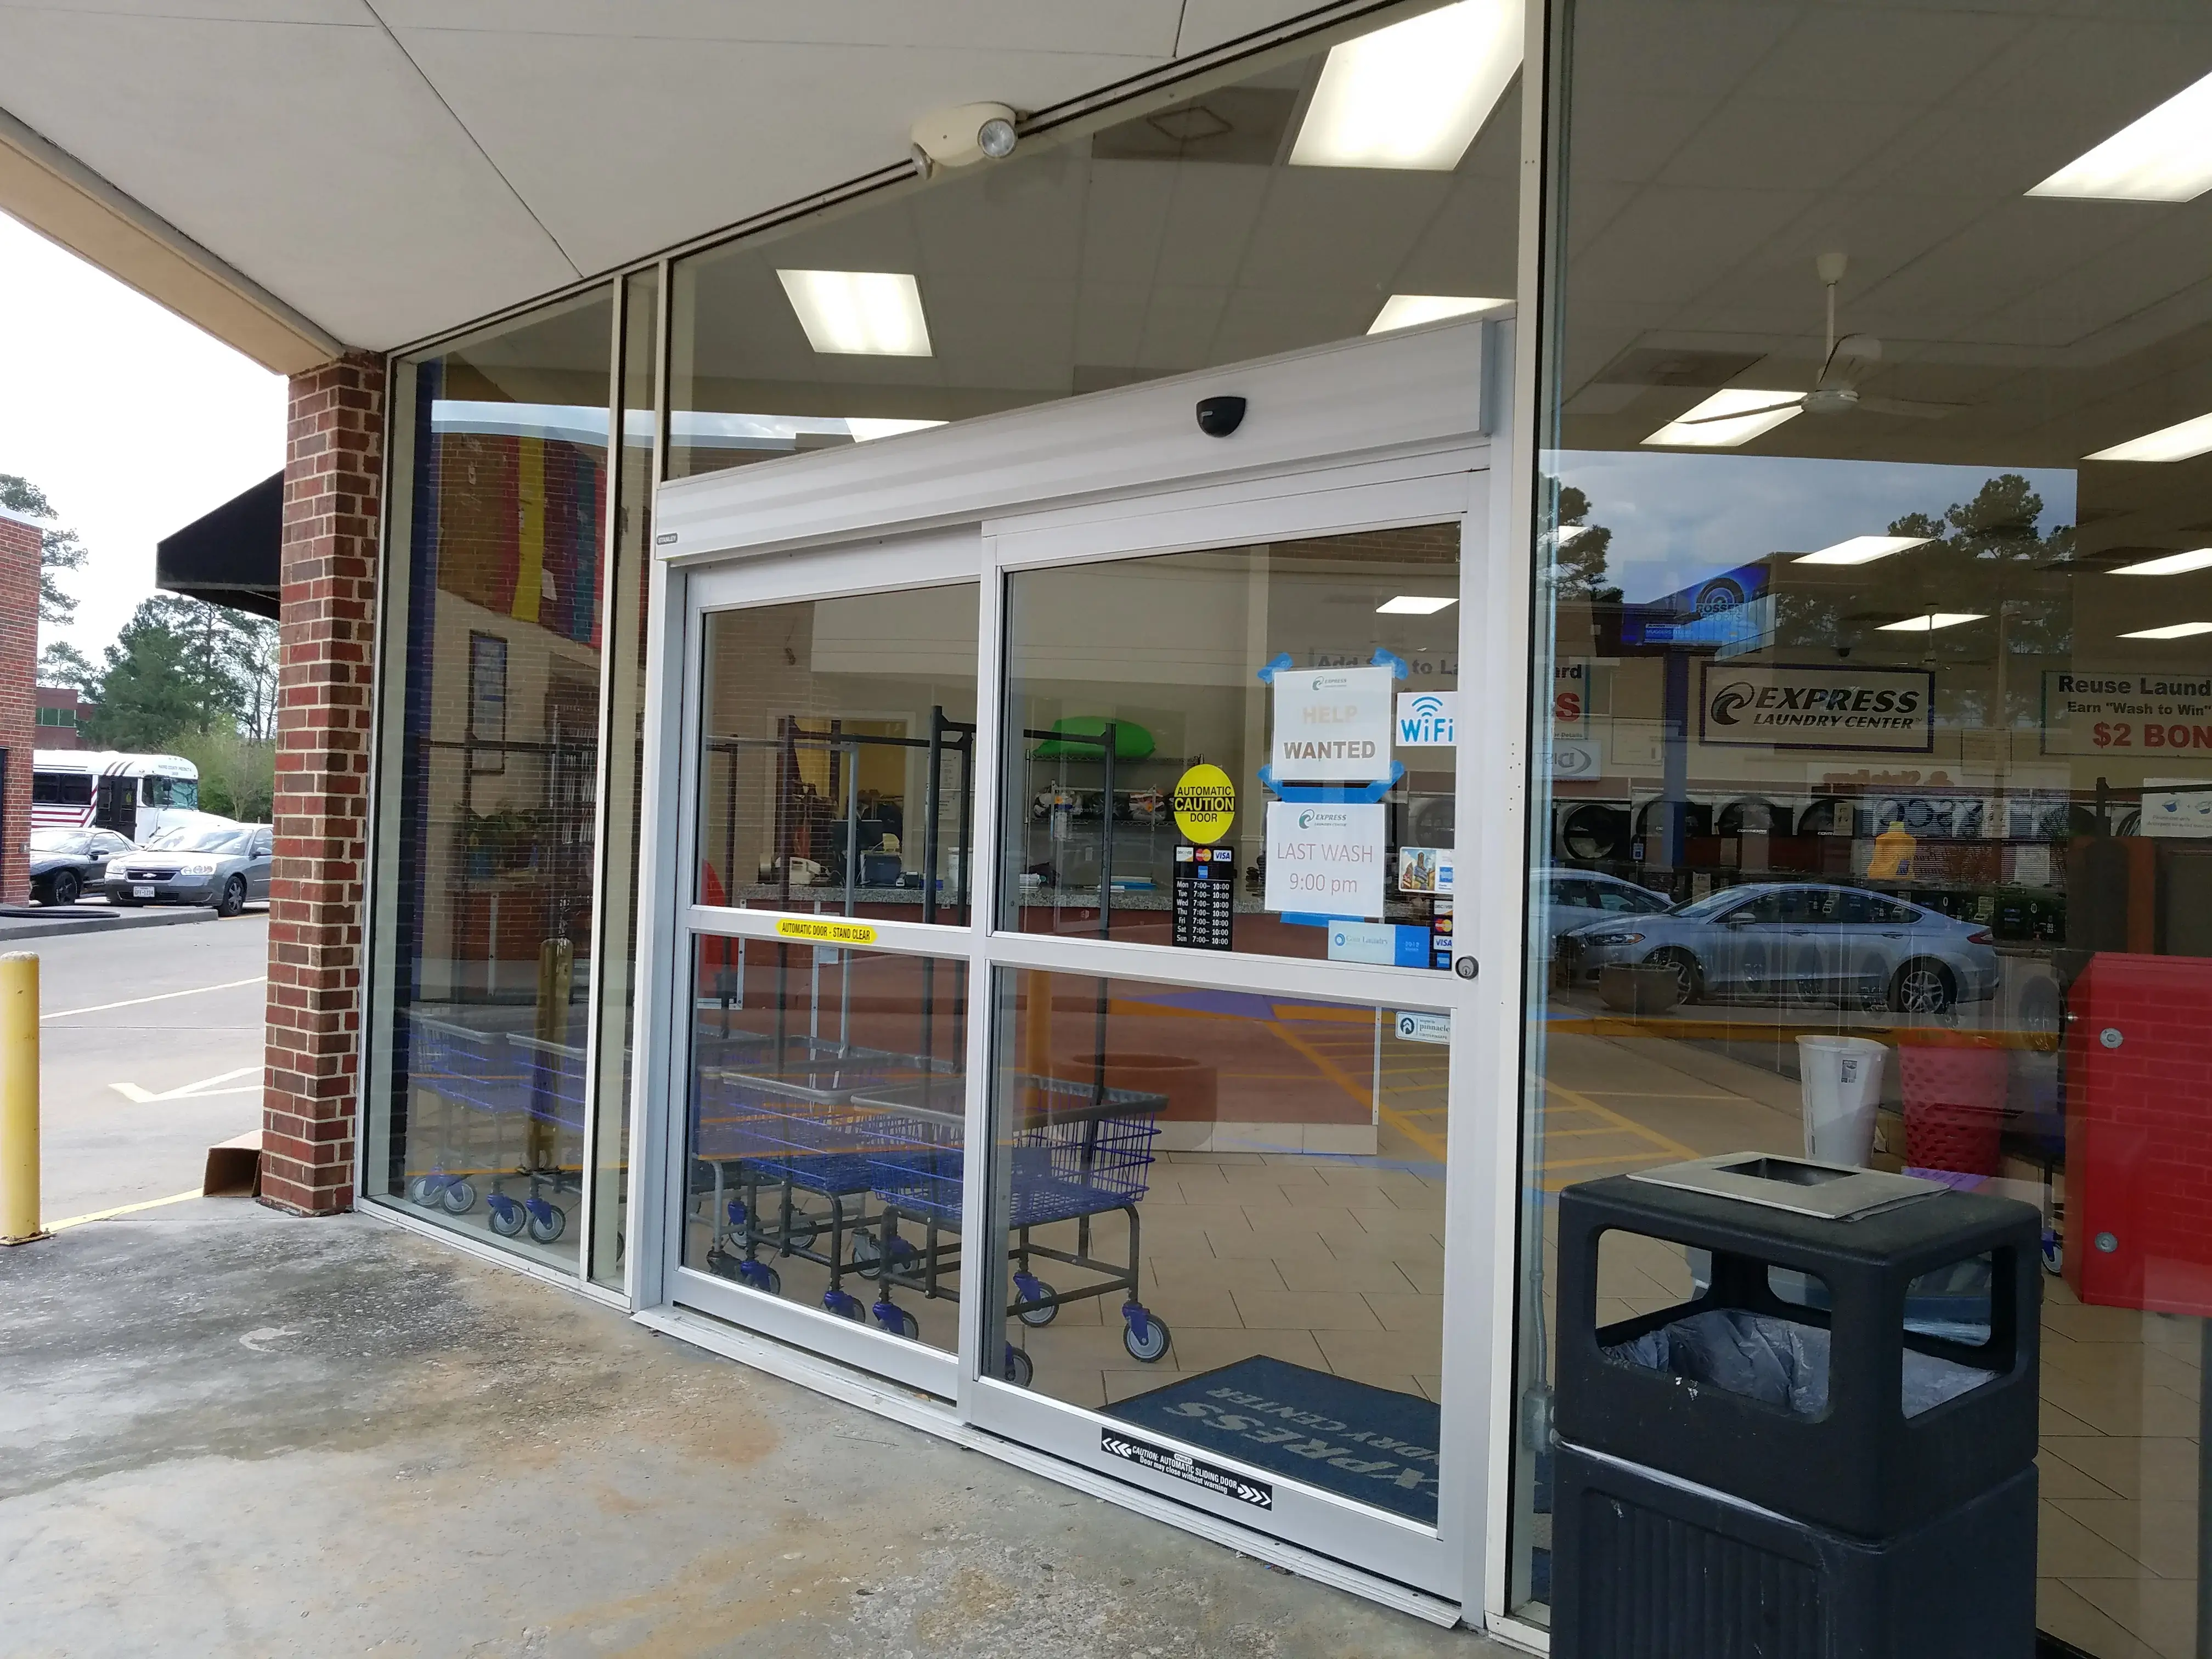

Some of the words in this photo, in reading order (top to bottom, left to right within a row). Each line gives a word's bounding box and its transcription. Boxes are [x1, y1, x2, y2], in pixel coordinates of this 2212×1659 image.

[658, 535, 676, 544] STANLEY
[1698, 613, 1741, 622] EPORTS
[1412, 659, 1433, 675] to
[2058, 675, 2132, 694] Reuse
[1756, 686, 1920, 714] EXPRESS
[2067, 701, 2101, 713] Earn
[2106, 702, 2153, 714] "Wash
[2157, 704, 2172, 715] to
[1302, 705, 1357, 724] HELP
[1753, 713, 1842, 727] LAUNDRY
[1845, 715, 1914, 729] CENTER
[1400, 718, 1454, 742] WiFi
[2092, 721, 2132, 748] $2
[1283, 741, 1376, 759] WANTED
[1177, 786, 1231, 795] AUTOMATIC
[1175, 797, 1234, 811] CAUTION
[1190, 813, 1217, 822] DOOR
[1277, 843, 1316, 860] LAST
[1322, 844, 1373, 862] WASH
[1289, 873, 1325, 891] 9:00
[1331, 879, 1357, 895] pm
[782, 922, 811, 935] AUTOMATIC
[812, 925, 827, 936] DOOR
[833, 927, 850, 938] STAND
[852, 929, 870, 940] CLEAR
[1436, 939, 1453, 947] VISA
[1206, 1388, 1347, 1431] CENTER
[1163, 1402, 1438, 1498] XPRESS
[1175, 1455, 1192, 1463] STANLEY
[1132, 1446, 1159, 1462] CAUTION:
[1160, 1455, 1194, 1474] AUTOMATIC
[1195, 1468, 1219, 1482] SLIDING
[1220, 1476, 1237, 1489] DOOR
[1139, 1456, 1153, 1466] Door
[1154, 1463, 1165, 1472] may
[1166, 1466, 1181, 1476] close
[1182, 1471, 1203, 1485] without
[1204, 1480, 1228, 1494] warning
